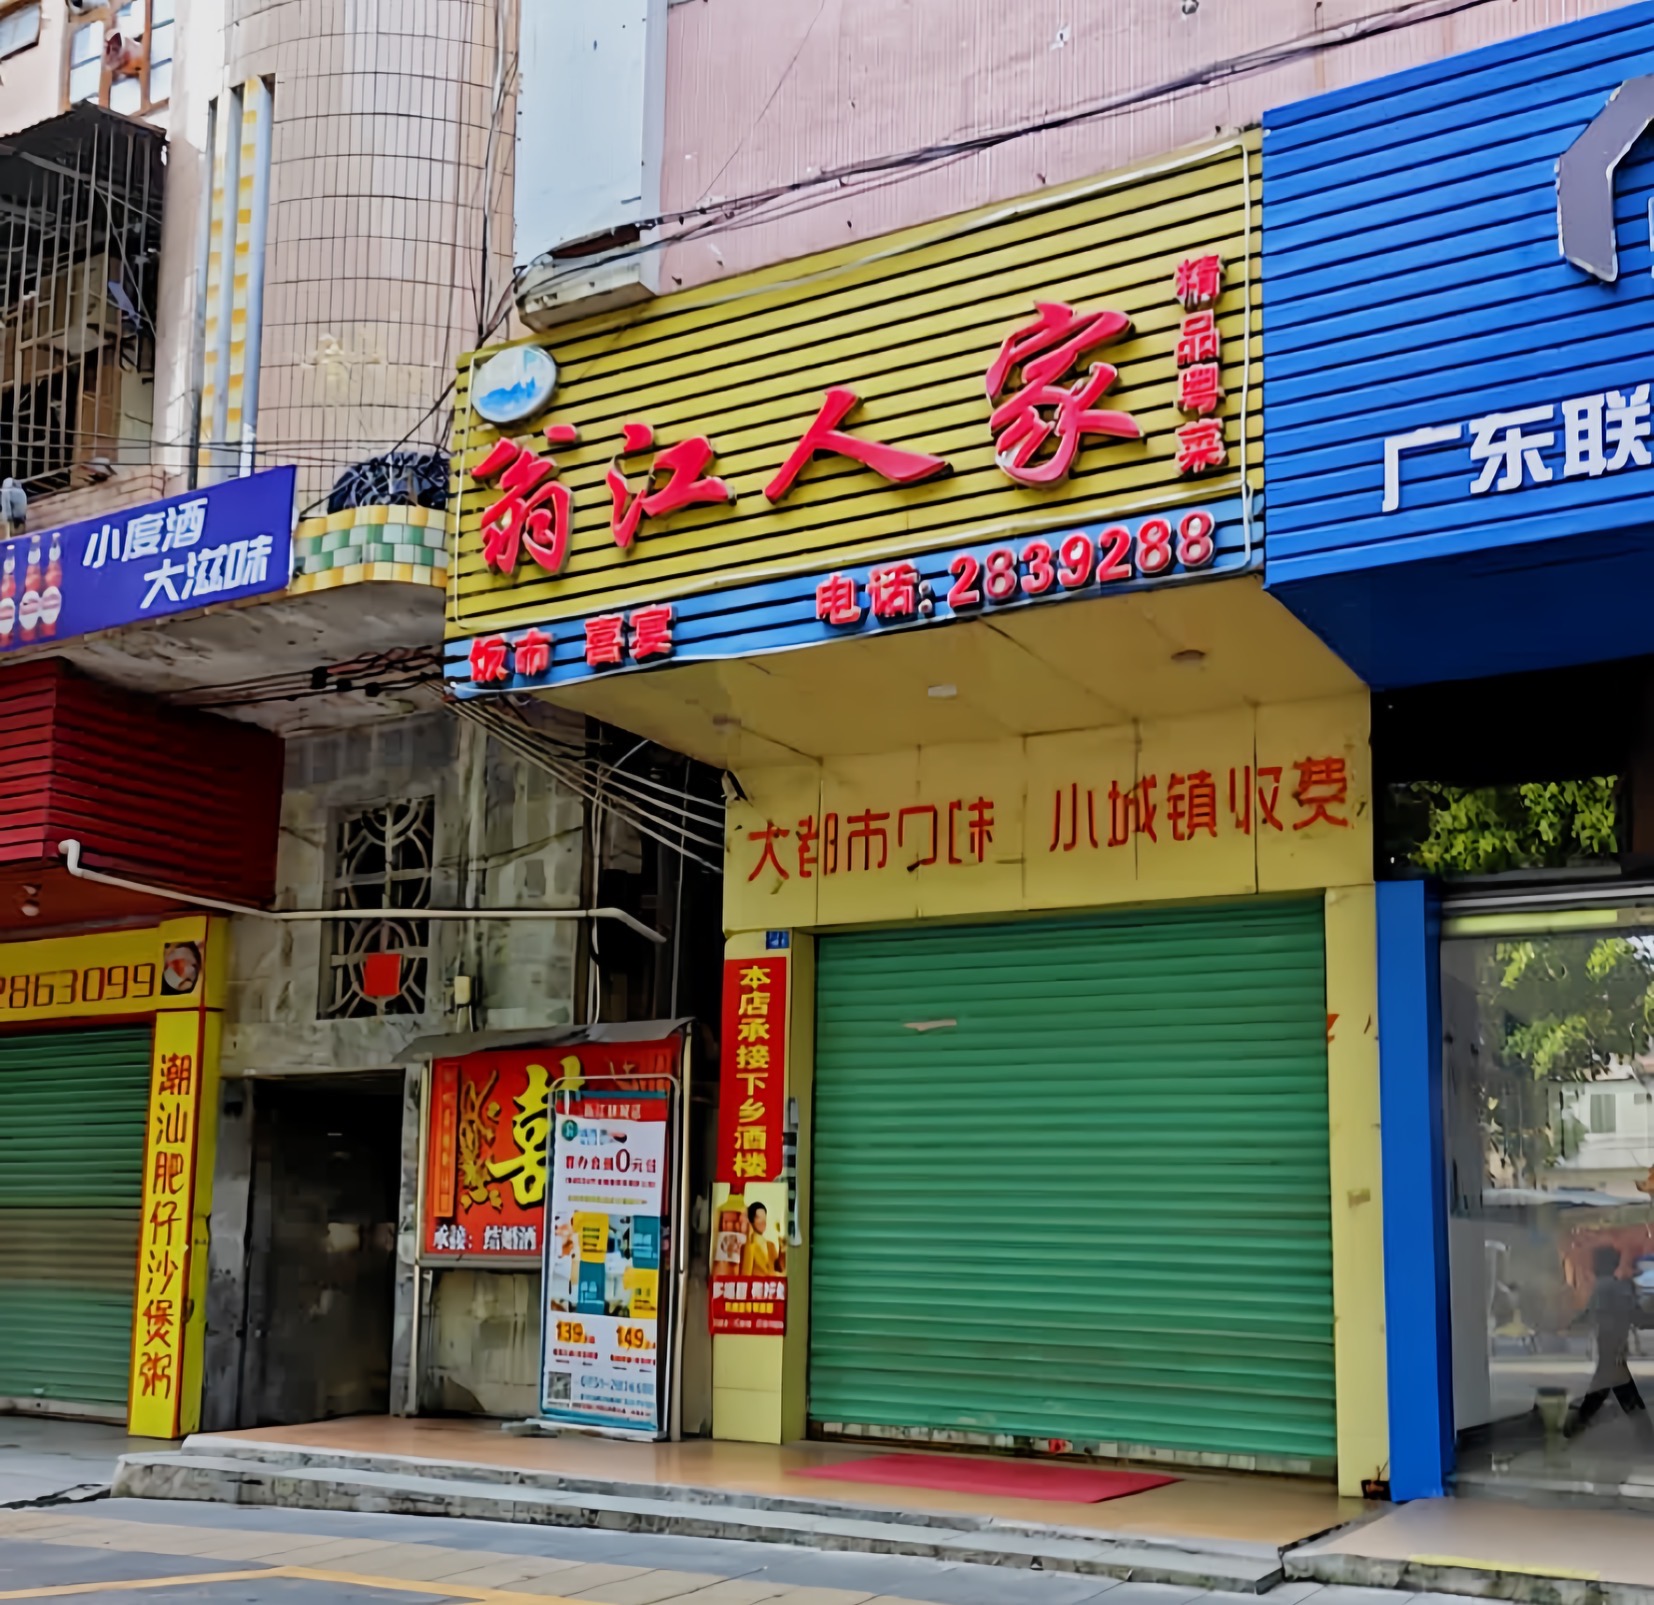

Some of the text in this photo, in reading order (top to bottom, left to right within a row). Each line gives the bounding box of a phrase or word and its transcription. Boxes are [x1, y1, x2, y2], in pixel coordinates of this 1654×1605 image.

[1175, 254, 1226, 476] 精品粤菜
[471, 301, 1144, 575] 翁江人家
[1382, 383, 1653, 513] 广东联
[82, 497, 209, 569] 小度酒
[139, 534, 274, 610] 大滋味
[469, 604, 673, 682] 饭市 喜宴
[1049, 756, 1350, 853] 小城镇收费
[732, 965, 771, 1178] 本店承接下乡酒楼
[139, 1053, 192, 1400] 潮汕肥仔沙煲粥
